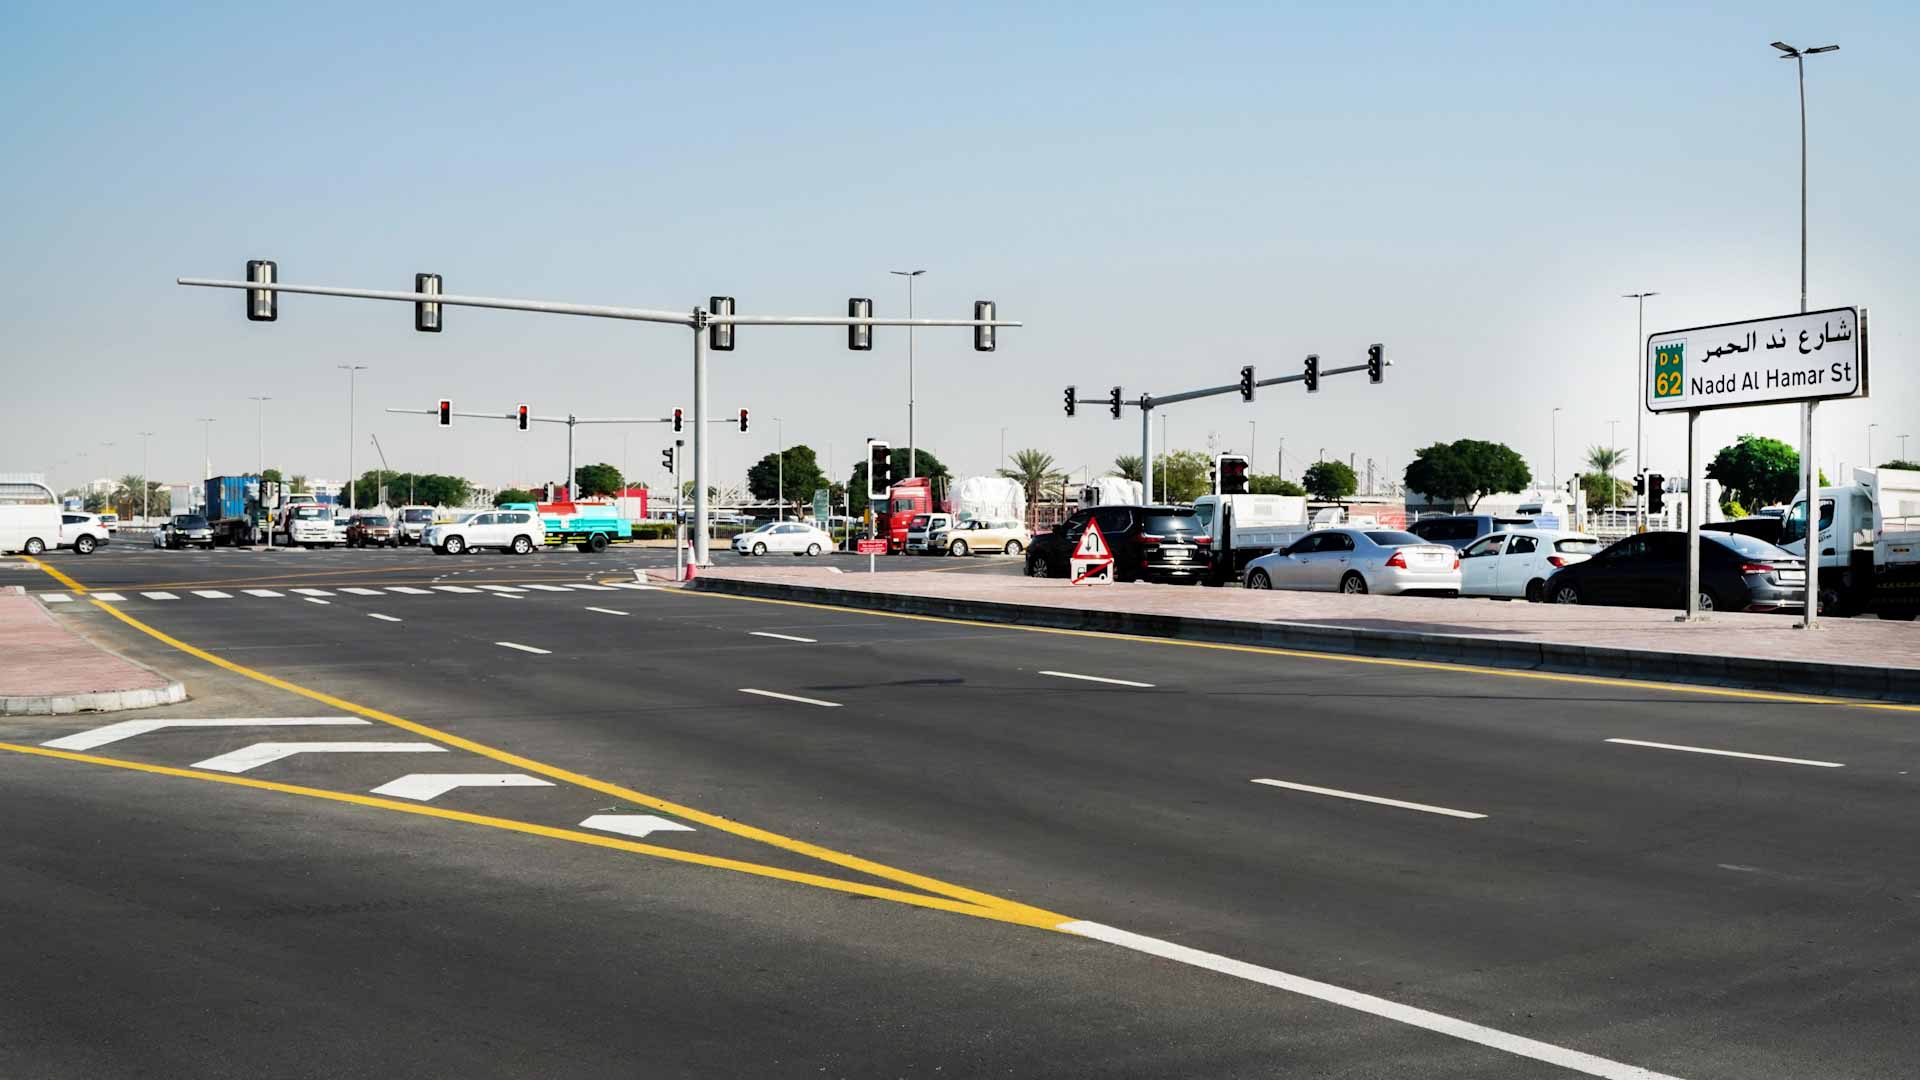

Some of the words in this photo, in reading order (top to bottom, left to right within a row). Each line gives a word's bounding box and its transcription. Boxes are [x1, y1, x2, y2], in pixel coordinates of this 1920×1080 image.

[1701, 330, 1756, 363] الحمر
[1766, 328, 1786, 349] ند
[1799, 320, 1851, 354] شارع
[1660, 352, 1668, 366] D
[1673, 354, 1679, 364] د
[1657, 371, 1681, 395] 62
[1691, 373, 1736, 395] Nadd
[1742, 371, 1759, 391] Al
[1767, 369, 1825, 389] Hamar
[1831, 362, 1851, 382] St
